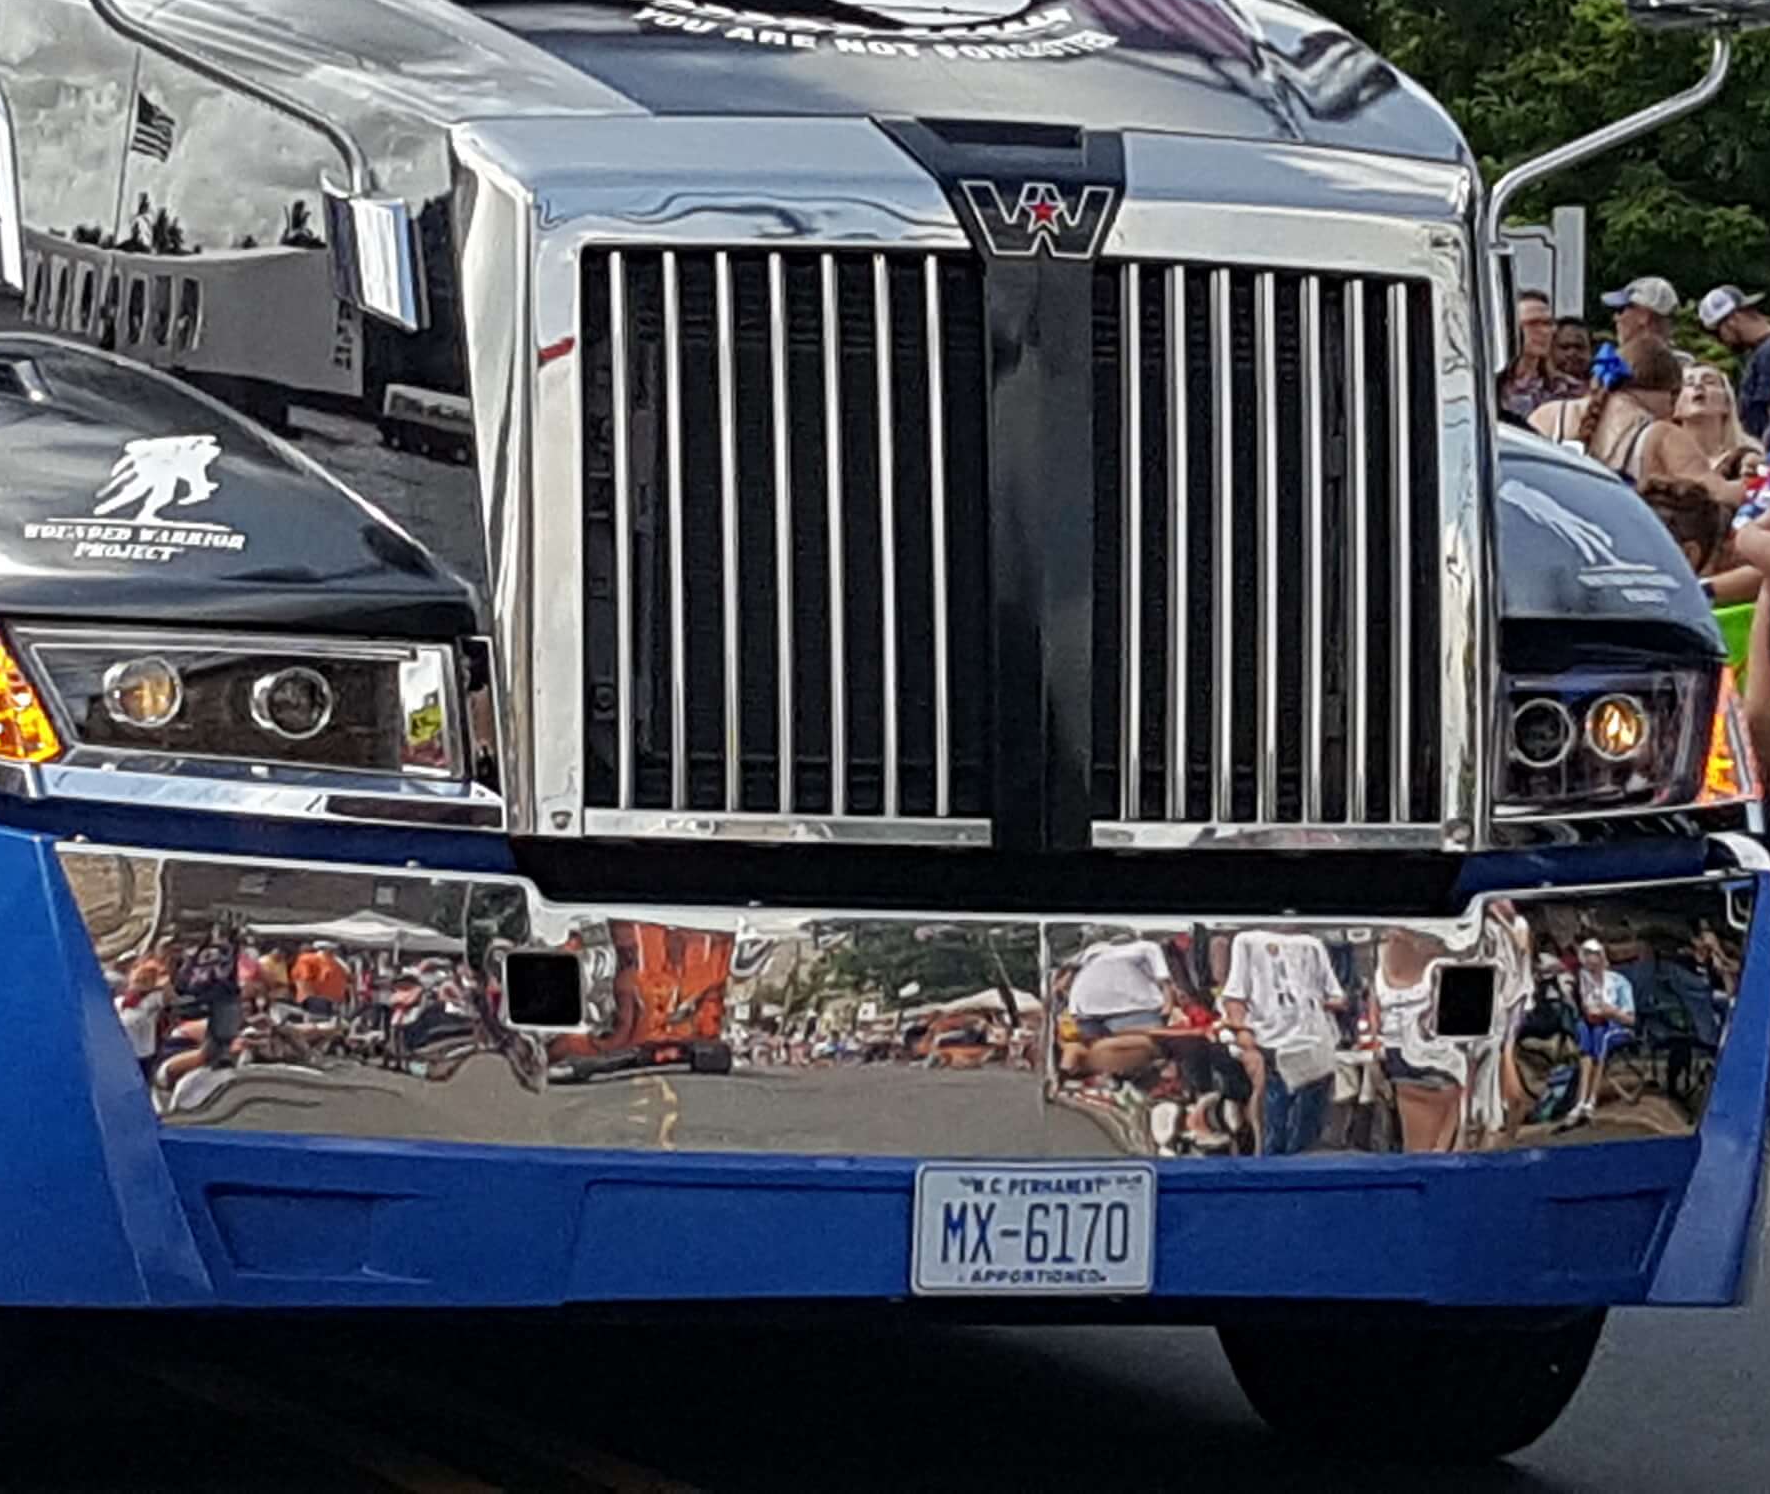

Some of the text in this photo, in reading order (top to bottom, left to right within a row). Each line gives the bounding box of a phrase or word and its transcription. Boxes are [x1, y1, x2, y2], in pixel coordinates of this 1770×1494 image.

[632, 8, 719, 33] YOU
[726, 27, 817, 49] ARE
[833, 38, 920, 59] NOT
[24, 523, 247, 551] WOUNDED WARRIOR
[74, 541, 180, 562] PROJECT
[1008, 1177, 1103, 1195] PERMANENT
[940, 1201, 1129, 1265] MX-6170
[970, 1269, 1101, 1284] APPORTIONED
